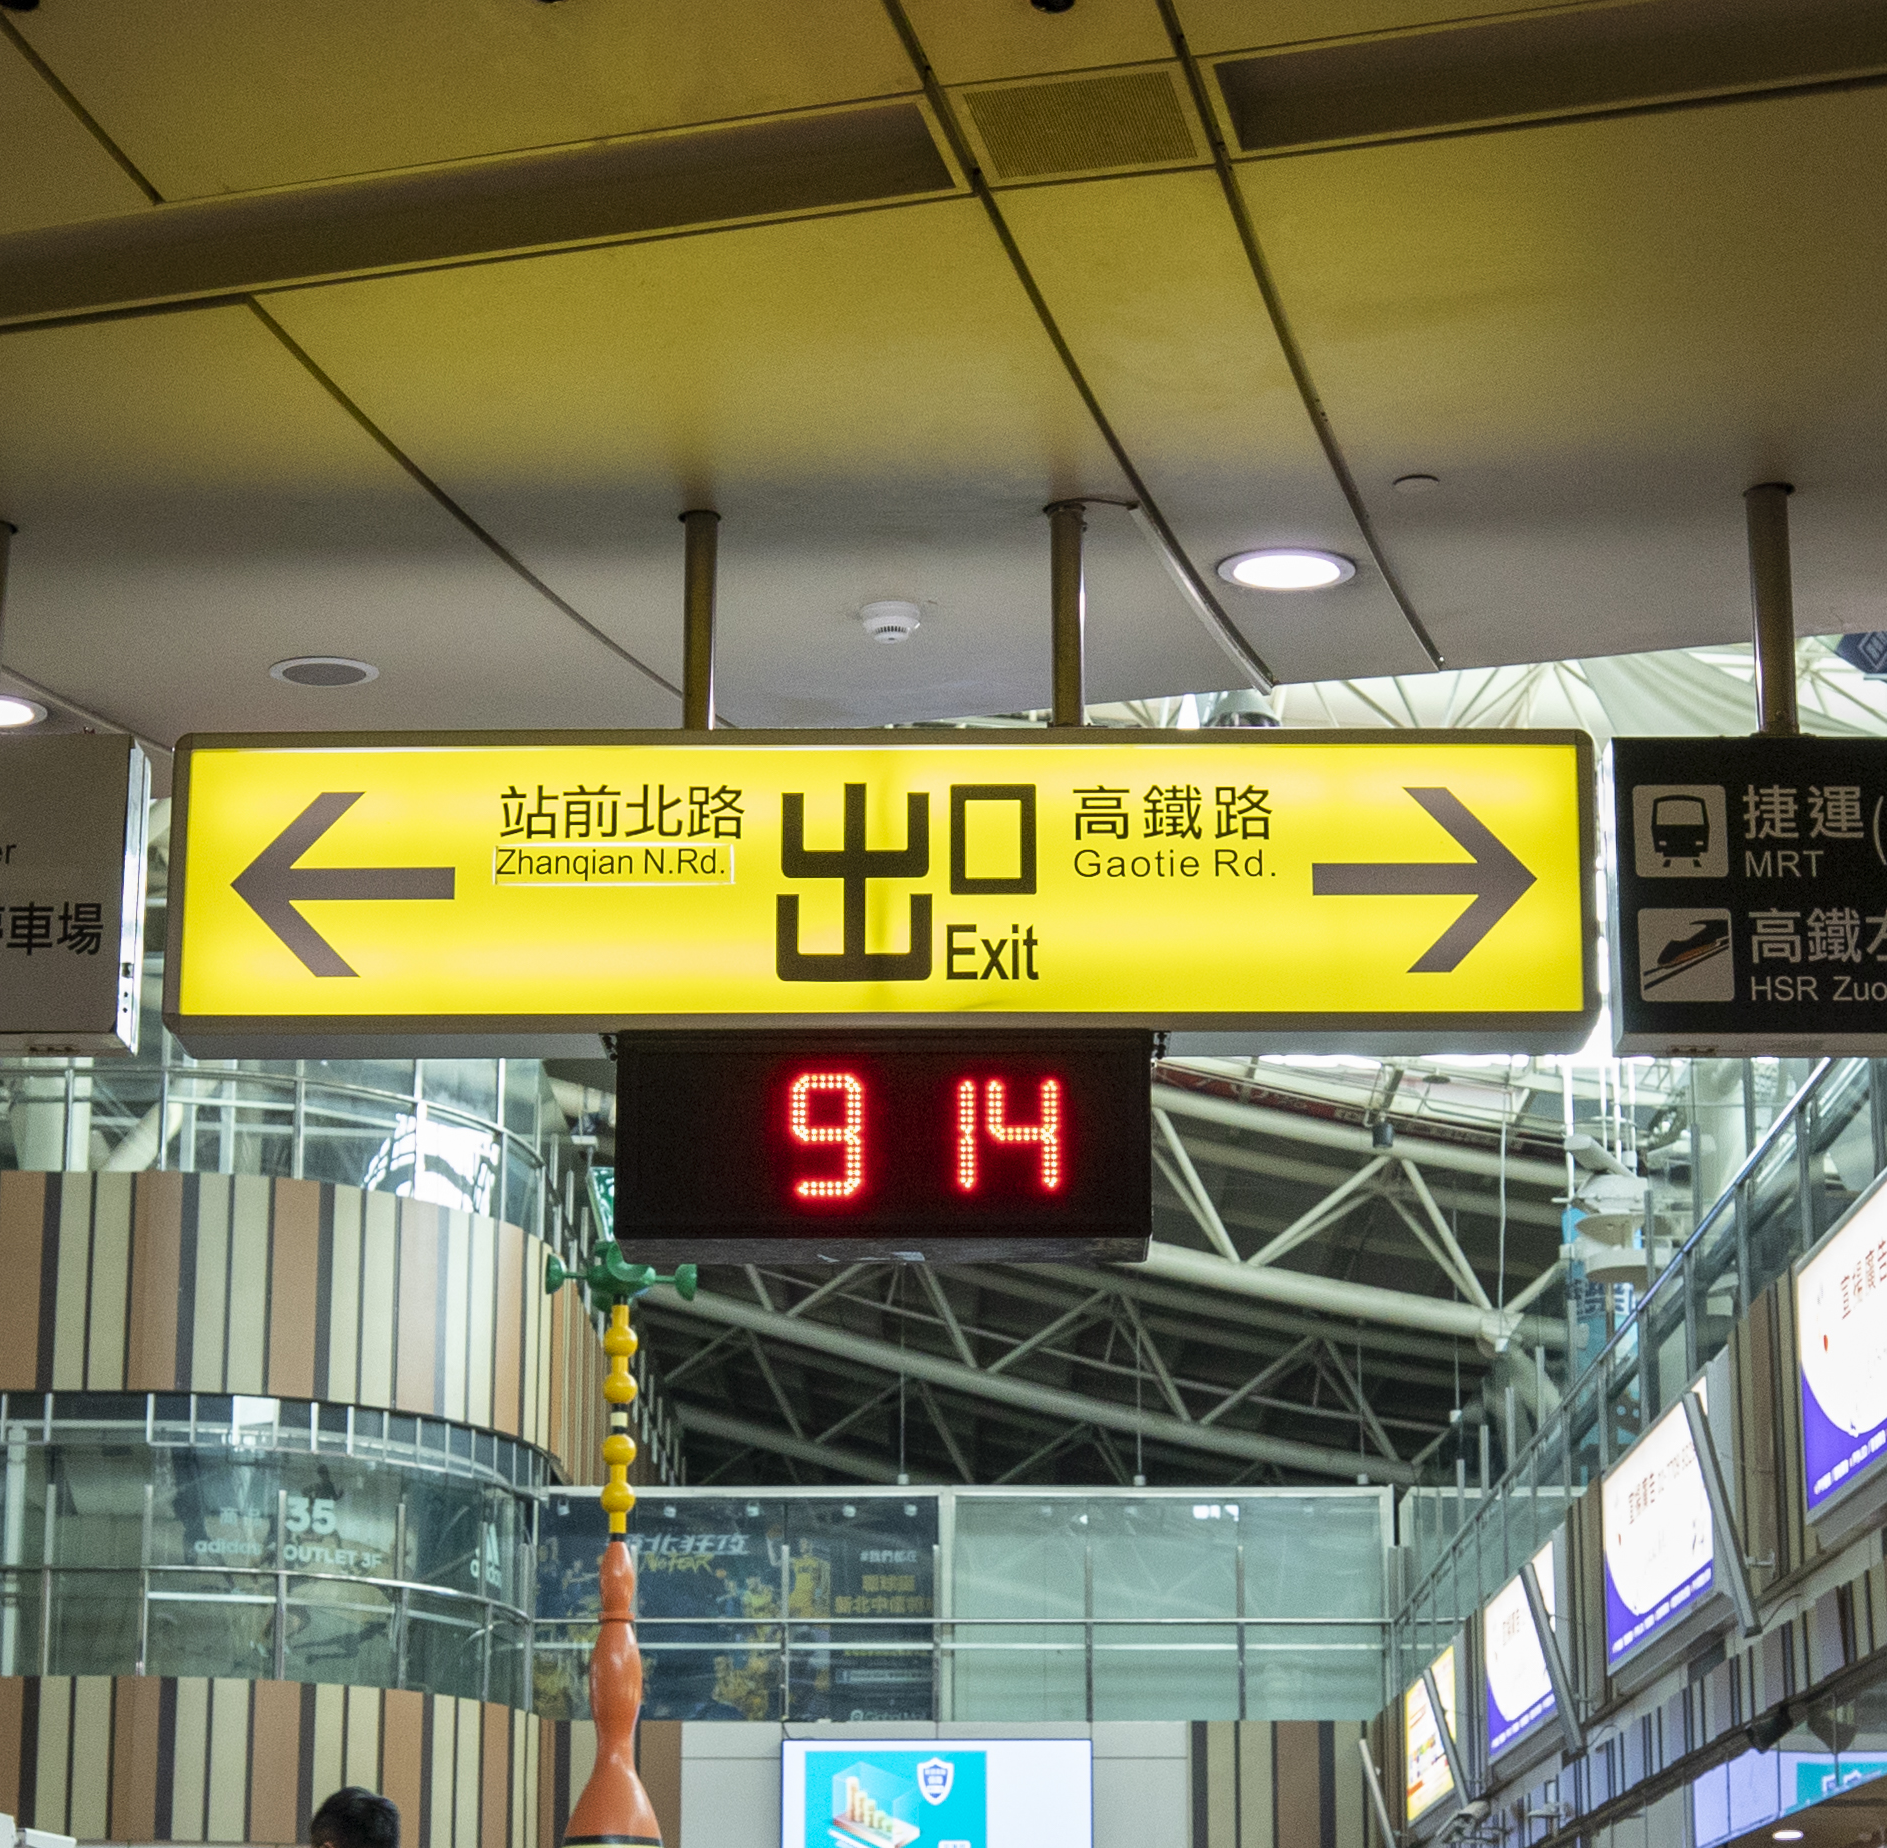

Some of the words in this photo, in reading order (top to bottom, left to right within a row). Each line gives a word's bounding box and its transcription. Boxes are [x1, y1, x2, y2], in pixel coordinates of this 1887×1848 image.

[499, 784, 745, 840] 站前北路
[1072, 784, 1273, 841] 高鐵路
[1743, 784, 1865, 840] 捷運
[496, 847, 634, 881] Zhanqian
[642, 847, 728, 876] N.Rd.
[775, 782, 1038, 982] 出口
[1073, 849, 1201, 878] Gaotie
[1214, 849, 1277, 878] Rd.
[1745, 850, 1824, 877] MRT
[945, 923, 1039, 981] Exit
[1751, 976, 1817, 1003] HSR
[792, 1073, 864, 1196] 9
[958, 1079, 1061, 1190] 14
[283, 1544, 358, 1566] OUTLET
